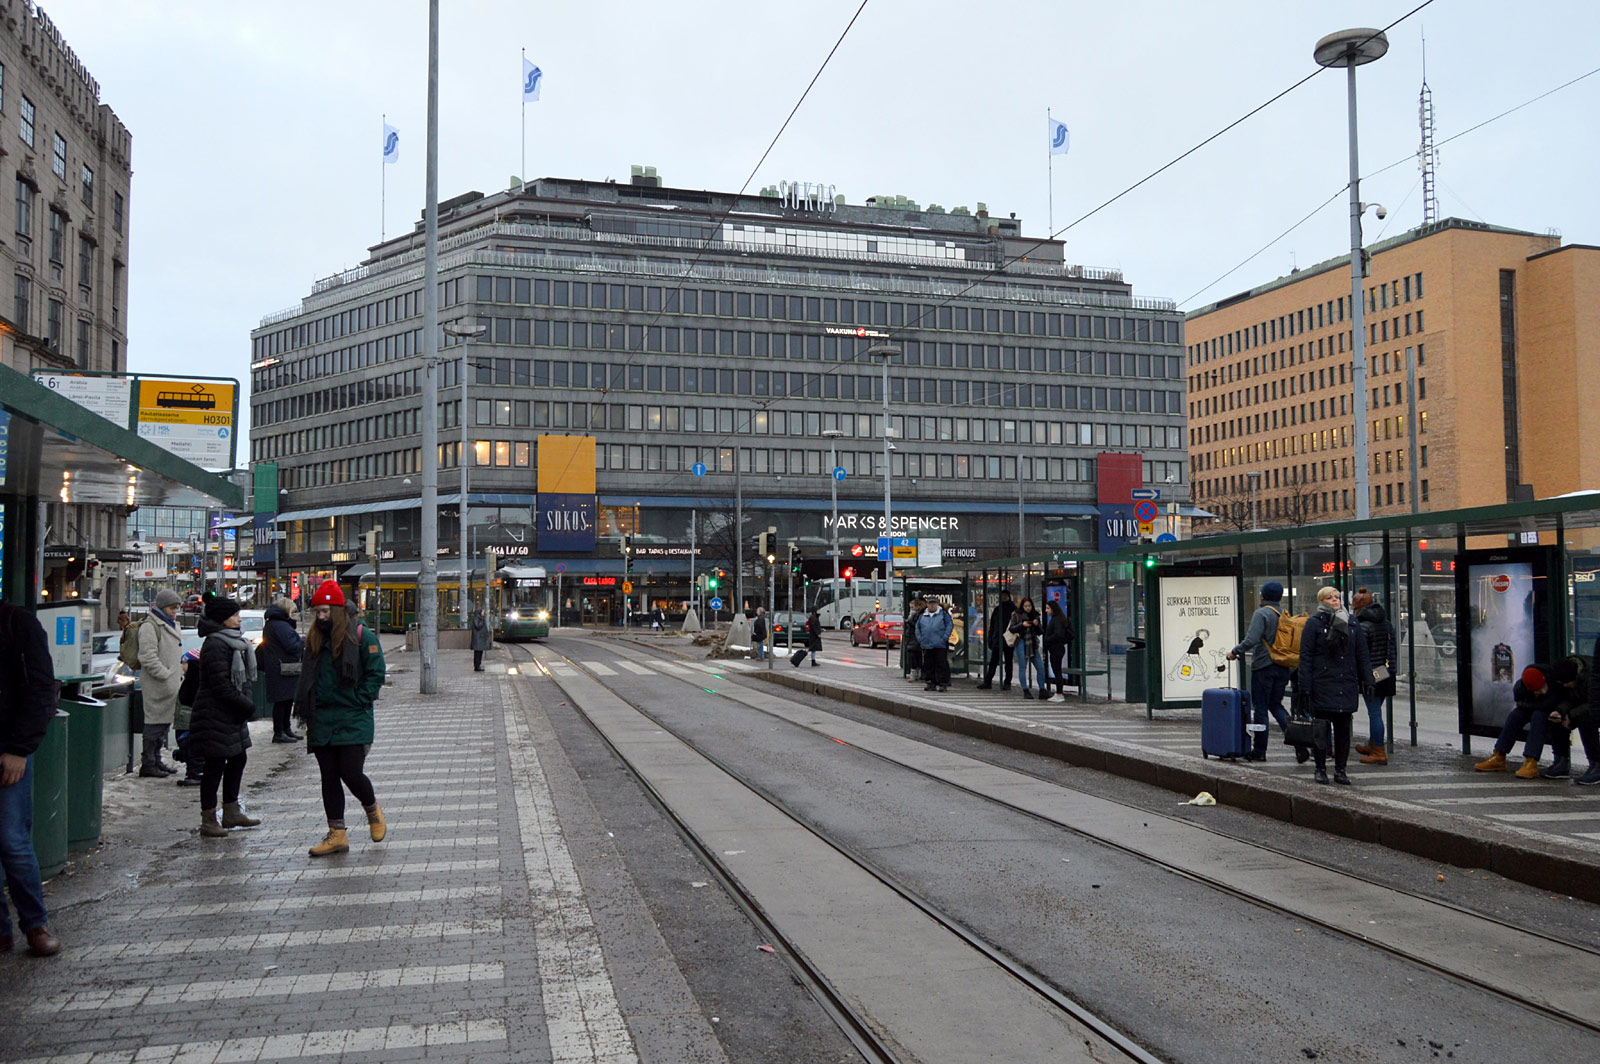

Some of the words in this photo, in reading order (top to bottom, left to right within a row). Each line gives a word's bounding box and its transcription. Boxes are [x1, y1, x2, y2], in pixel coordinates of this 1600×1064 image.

[779, 179, 837, 213] SOKOS
[826, 327, 857, 335] VAAKUNA
[203, 415, 230, 425] H0301
[546, 510, 587, 530] SOKOS
[823, 515, 876, 530] MARKS
[890, 516, 959, 530] SPENCER
[957, 548, 977, 557] HOUSE
[515, 579, 521, 587] 7
[1193, 596, 1212, 606] TOISEN
[1213, 595, 1231, 605] ETEEN
[1178, 608, 1187, 617] JA
